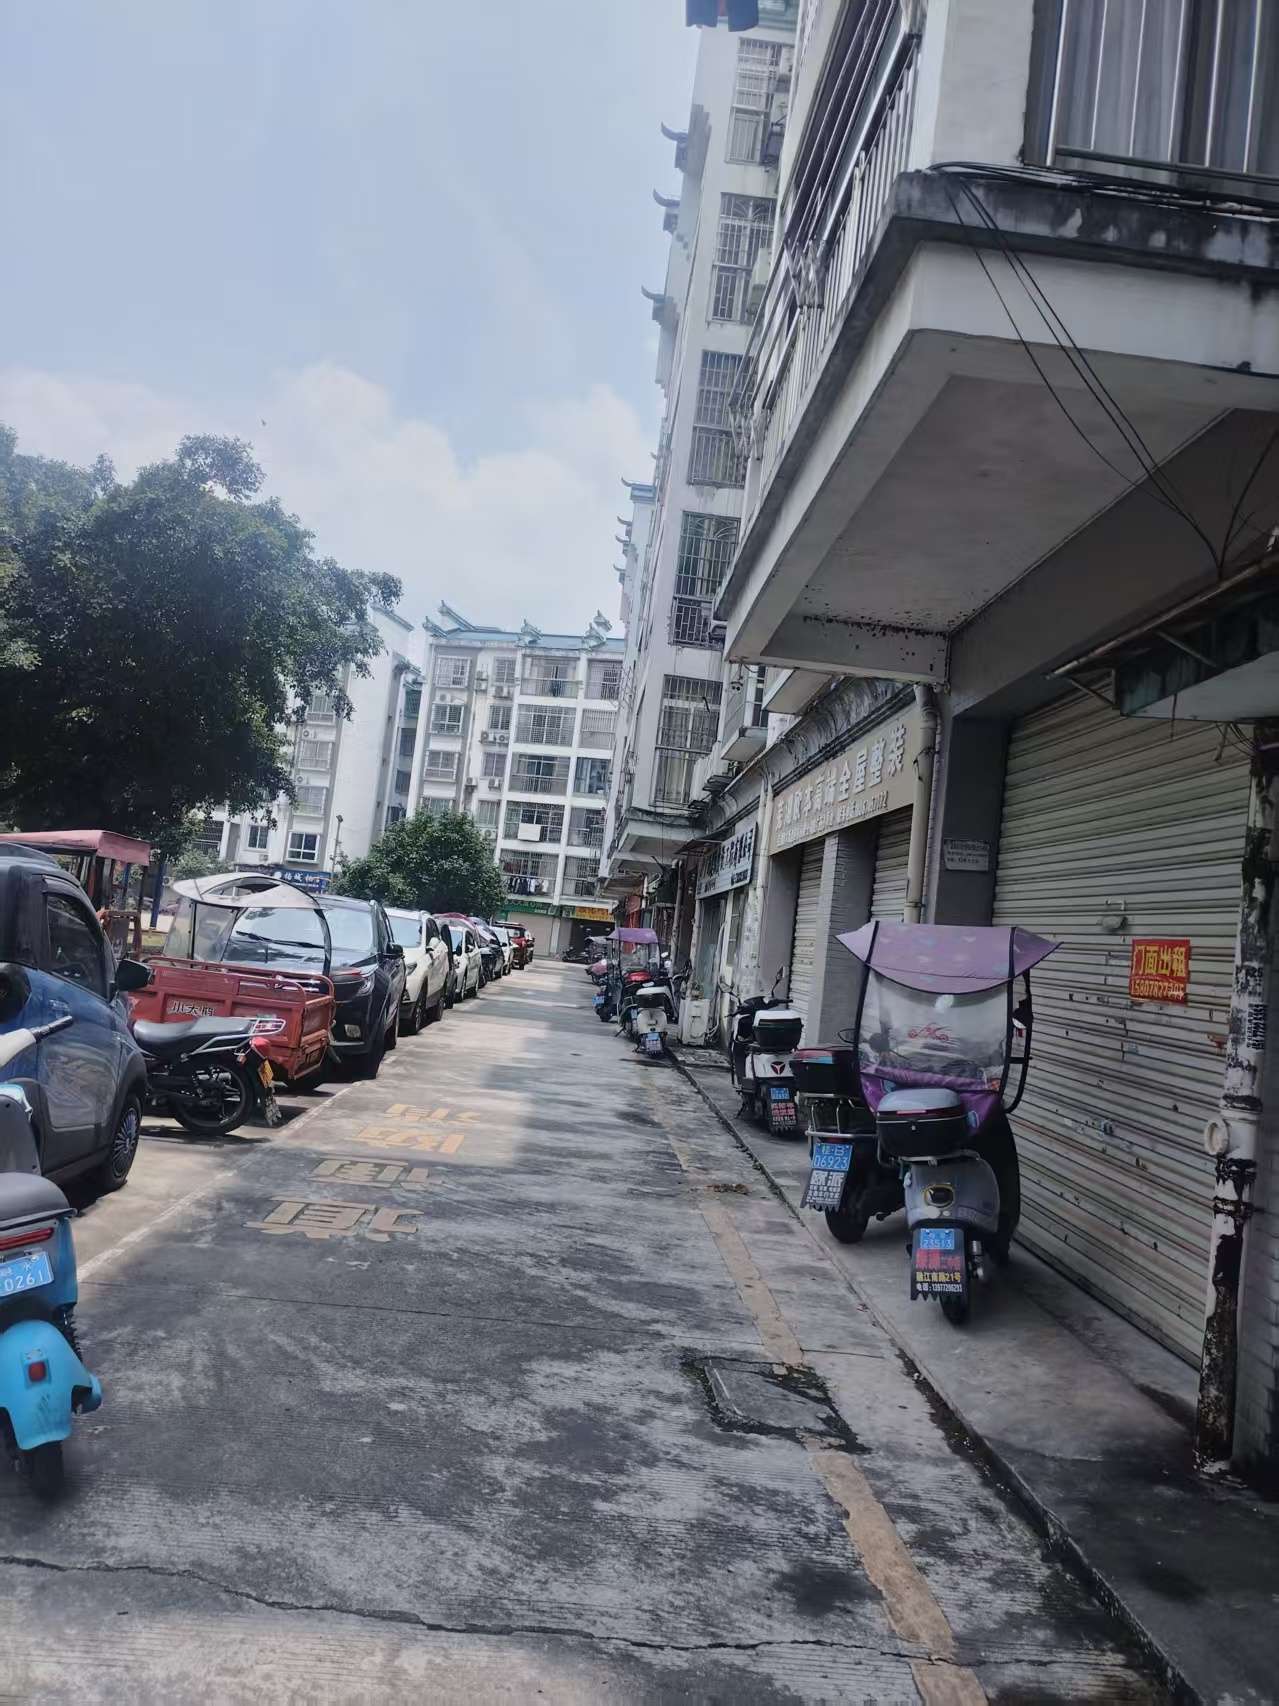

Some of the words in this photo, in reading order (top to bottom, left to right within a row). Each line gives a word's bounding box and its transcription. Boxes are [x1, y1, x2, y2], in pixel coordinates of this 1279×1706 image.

[1132, 944, 1187, 977] 门面出租
[4, 1269, 44, 1292] 0261
